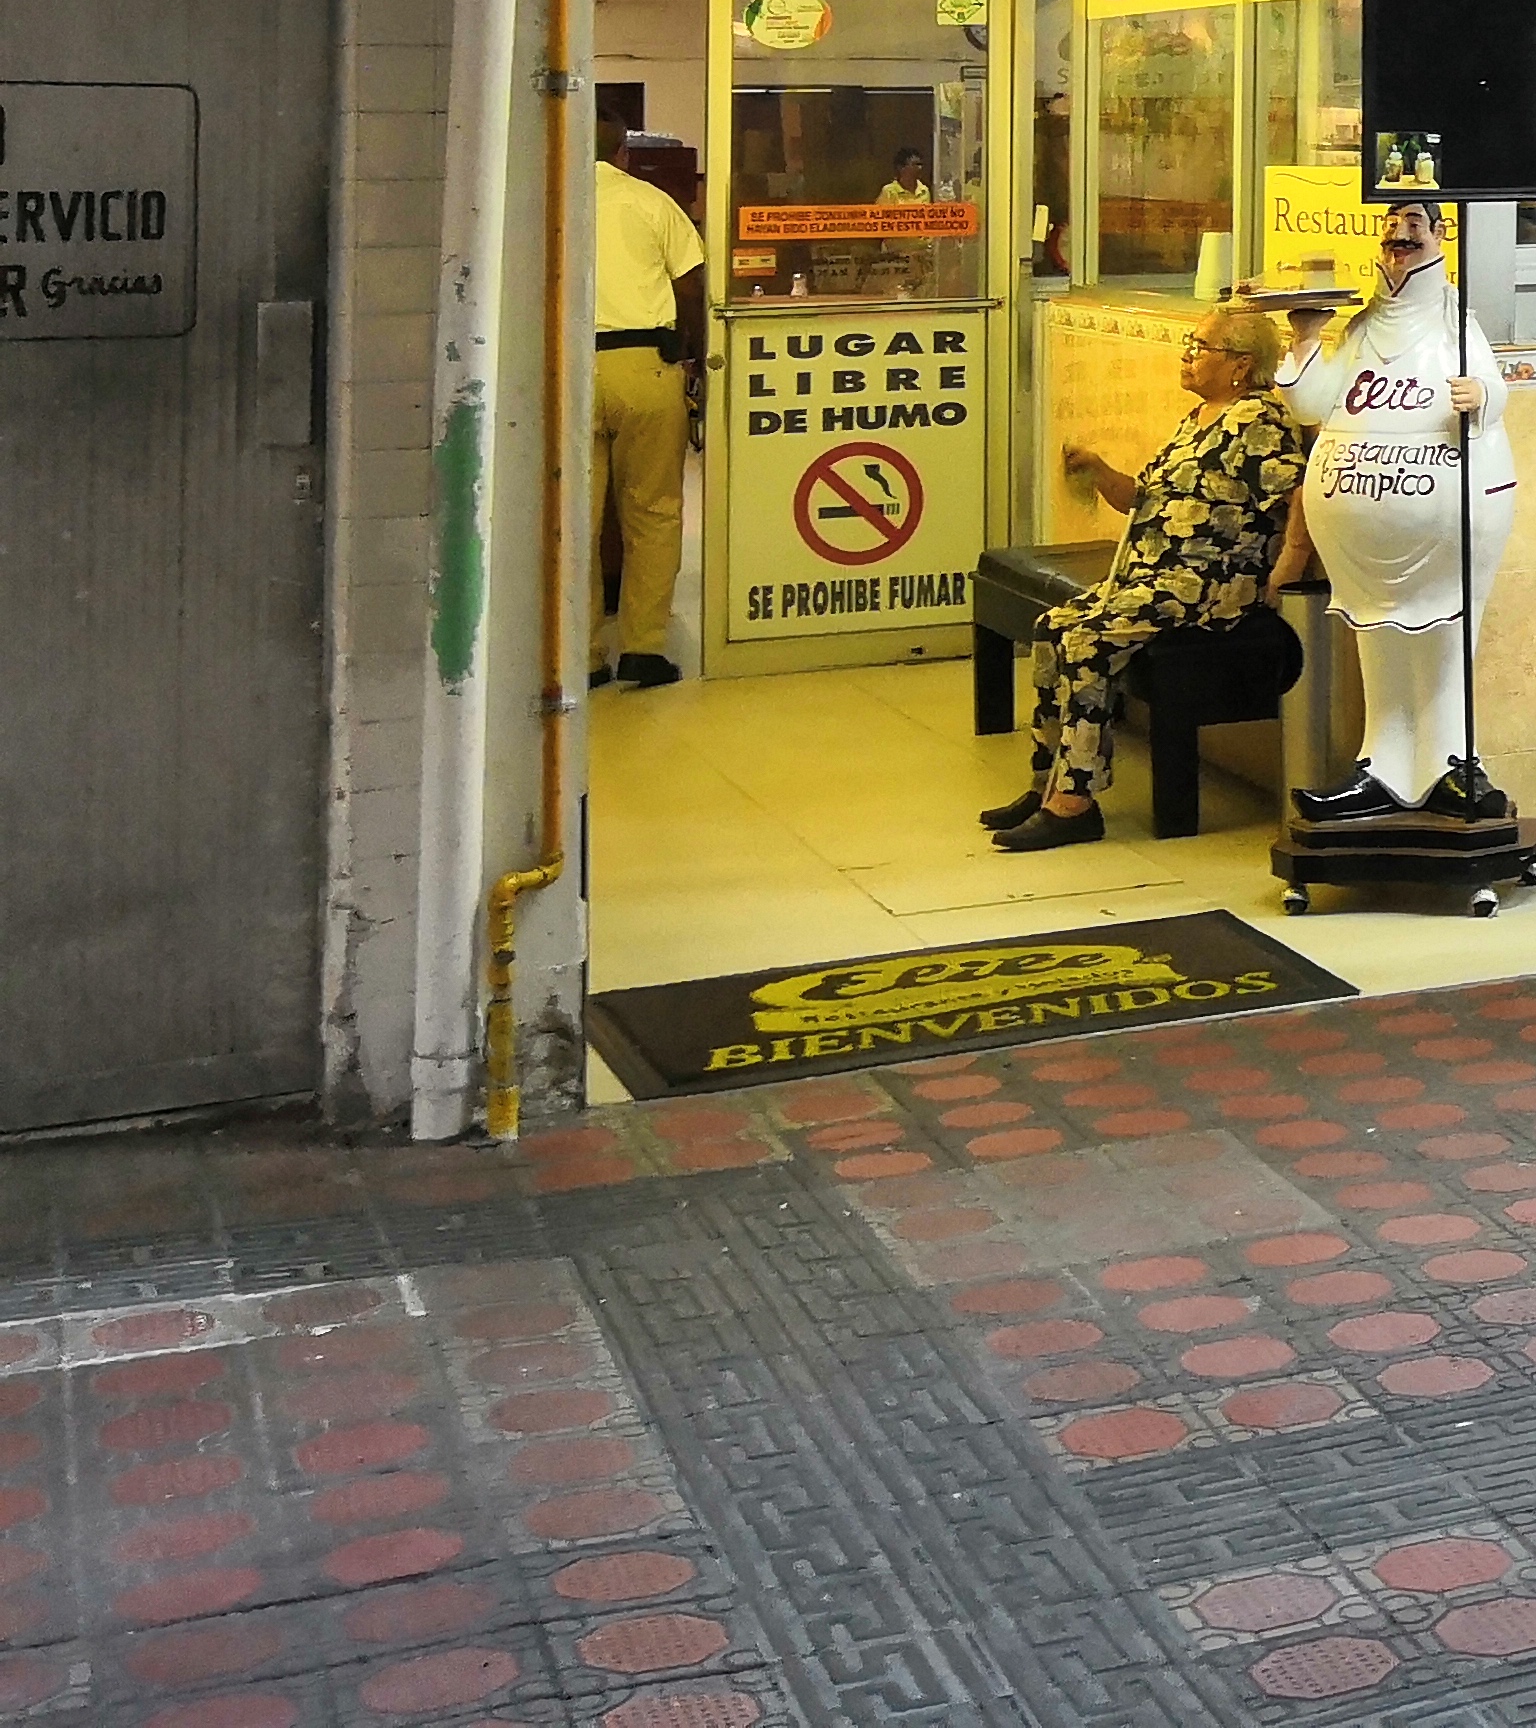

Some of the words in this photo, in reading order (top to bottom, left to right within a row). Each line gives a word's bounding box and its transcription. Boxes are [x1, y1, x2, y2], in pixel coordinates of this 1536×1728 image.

[1274, 197, 1459, 242] Restaure
[41, 267, 163, 309] Gracias
[748, 330, 968, 361] LUGAR
[748, 365, 967, 399] LIBRE
[1345, 369, 1436, 416] Elite
[748, 409, 808, 438] DE
[822, 402, 968, 433] HUMO
[1316, 438, 1463, 468] Restaurante
[1323, 467, 1436, 502] Tampico
[747, 584, 773, 622] SE
[781, 576, 881, 619] PROHIBE
[888, 572, 967, 611] FUMAR
[702, 970, 1282, 1072] BIENVENIDOS
